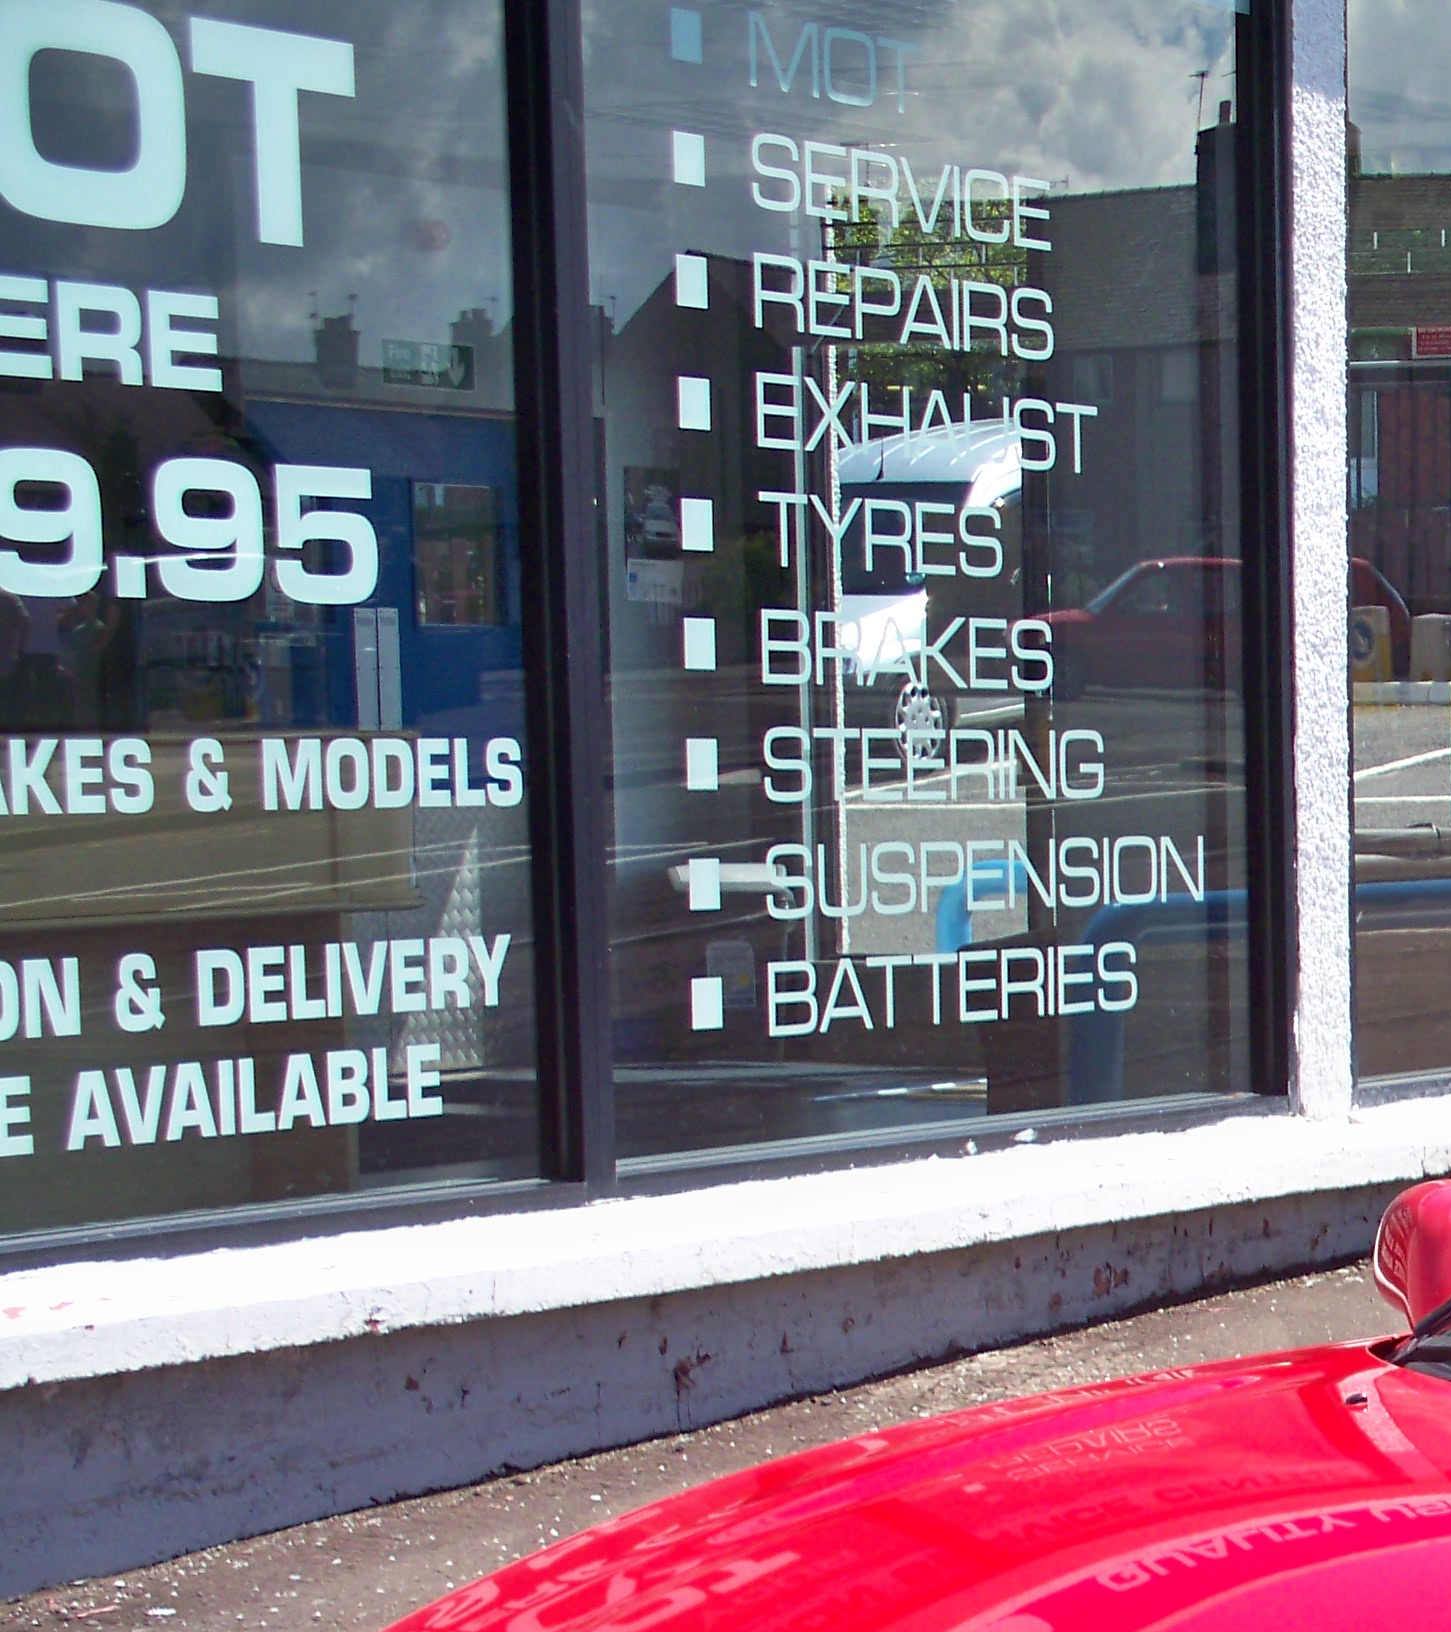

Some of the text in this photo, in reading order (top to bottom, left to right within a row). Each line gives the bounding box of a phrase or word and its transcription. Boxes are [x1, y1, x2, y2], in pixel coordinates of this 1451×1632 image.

[747, 12, 924, 115] MOT
[751, 132, 1053, 253] SERVICE
[753, 251, 1056, 363] REPAIRS
[756, 371, 1099, 475] EXHAUST
[0, 447, 379, 605] 9.95
[758, 490, 1004, 578] TYRES
[759, 607, 1056, 691] BRAKES
[0, 737, 524, 815] KES & MODELS
[762, 725, 1105, 804] STEERING
[763, 834, 1206, 921] SUSPENSION
[114, 953, 166, 1032] &
[196, 932, 512, 1029] DELIVERY
[766, 941, 1140, 1039] BATTERIES
[66, 1043, 444, 1152] AVAILABLE
